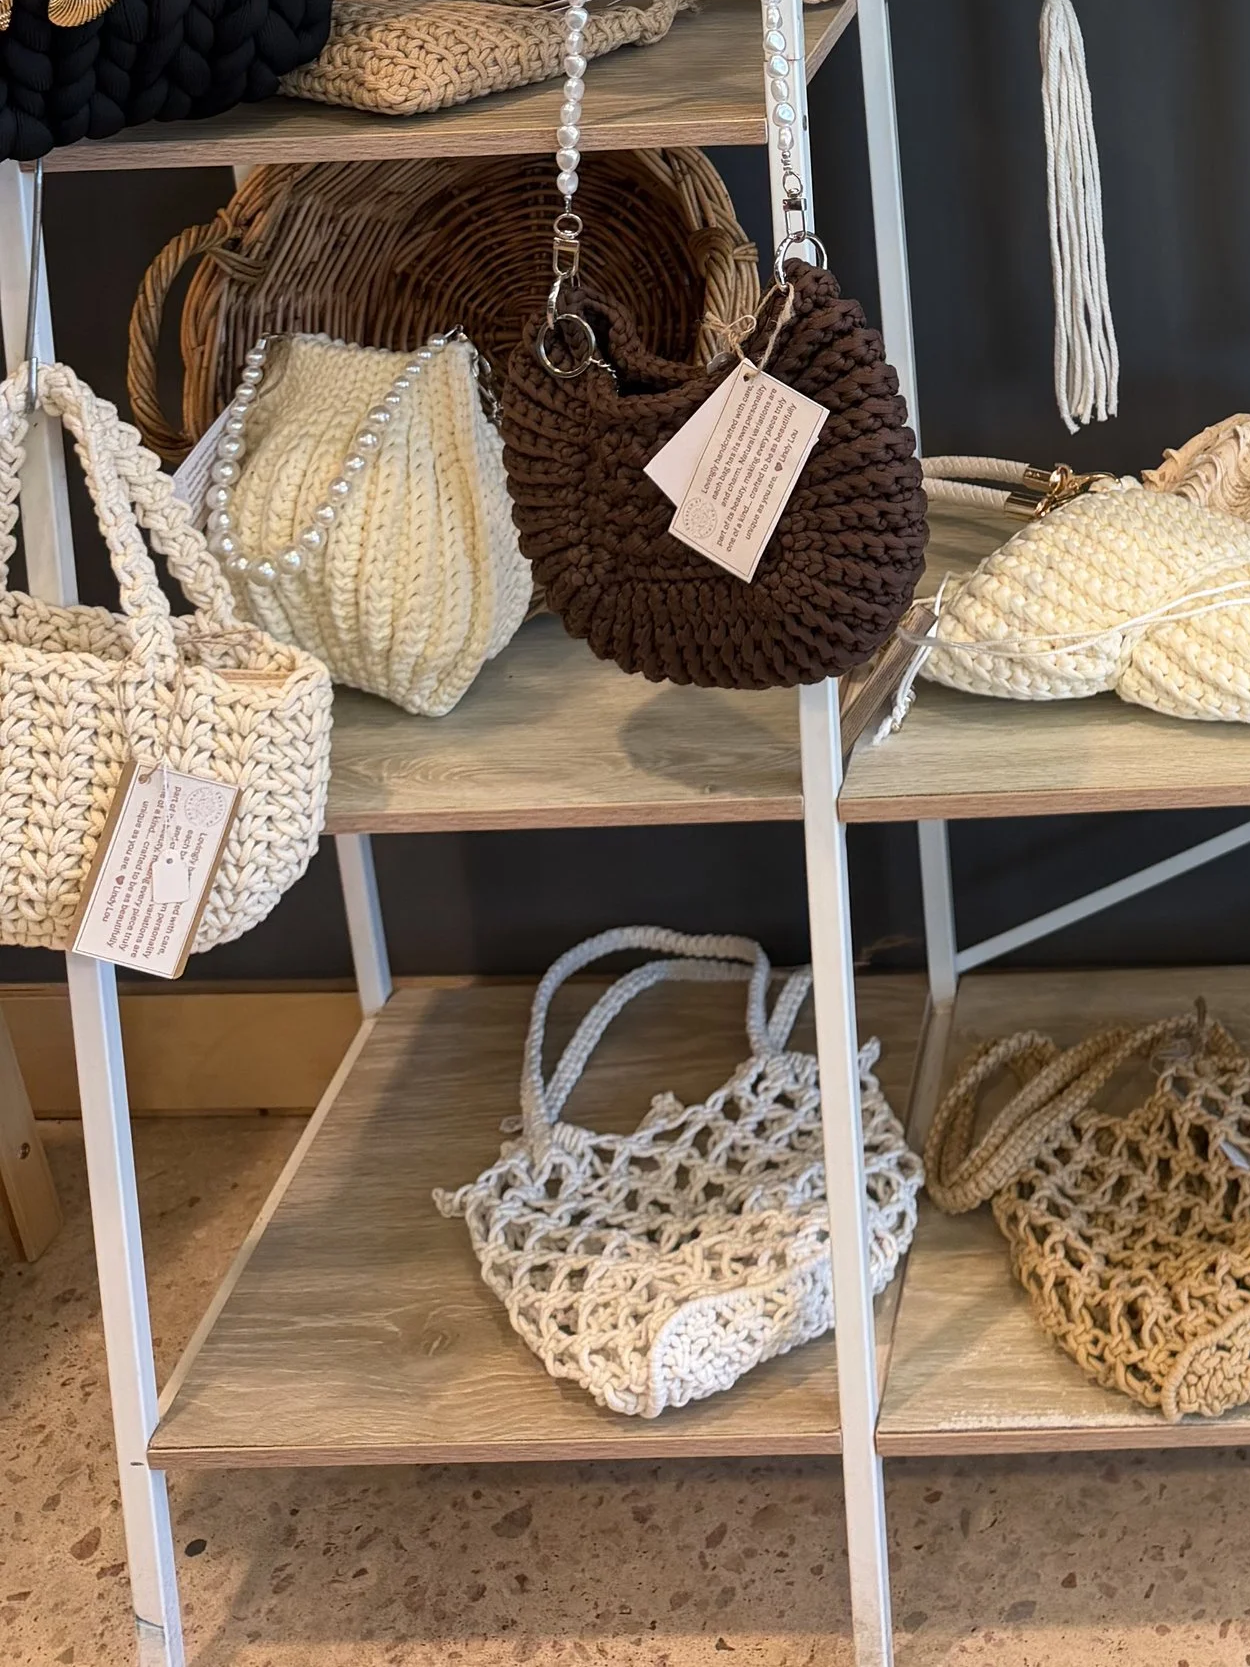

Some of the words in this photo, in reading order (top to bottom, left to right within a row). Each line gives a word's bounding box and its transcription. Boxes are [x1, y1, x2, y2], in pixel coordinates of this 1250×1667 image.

[744, 383, 767, 427] personality
[774, 396, 787, 415] truly
[765, 415, 778, 438] piece
[773, 402, 797, 443] beautifully
[737, 425, 749, 442] own
[700, 463, 719, 495] Lovingly
[713, 418, 739, 465] handcrafted
[735, 402, 746, 419] with
[721, 491, 731, 508] and
[737, 436, 756, 466] Natural
[751, 400, 772, 437] variations
[768, 388, 778, 401] are
[731, 442, 741, 453] its
[756, 435, 770, 457] every
[770, 443, 778, 454] as
[724, 452, 737, 467] has
[764, 453, 774, 464] be
[718, 466, 731, 482] bag
[743, 456, 761, 485] making
[760, 463, 769, 473] to
[712, 481, 723, 500] each
[745, 513, 760, 541] unique
[756, 503, 765, 514] as
[761, 489, 772, 505] you
[778, 442, 793, 463] Lindy
[787, 429, 799, 444] Lou
[749, 471, 765, 500] crafted
[723, 520, 730, 531] of
[726, 511, 735, 522] its
[716, 529, 727, 547] part
[732, 527, 740, 538] of
[726, 537, 737, 553] one
[171, 785, 182, 803] part
[156, 799, 165, 809] of
[168, 803, 177, 813] of
[134, 800, 149, 829] unique
[131, 829, 140, 839] as
[182, 829, 194, 850] each
[125, 839, 136, 856] you
[135, 841, 150, 871] crafted
[189, 832, 208, 866] Lovingly
[131, 871, 141, 881] to
[127, 881, 138, 892] be
[106, 885, 122, 907] Lindy
[123, 892, 132, 903] as
[134, 885, 148, 908] every
[102, 906, 114, 923] Lou
[126, 907, 140, 931] piece
[135, 903, 155, 943] variations
[106, 904, 129, 948] beautifully
[165, 916, 177, 934] with
[118, 932, 133, 952] truly
[142, 912, 165, 959] personality
[130, 944, 140, 958] are
